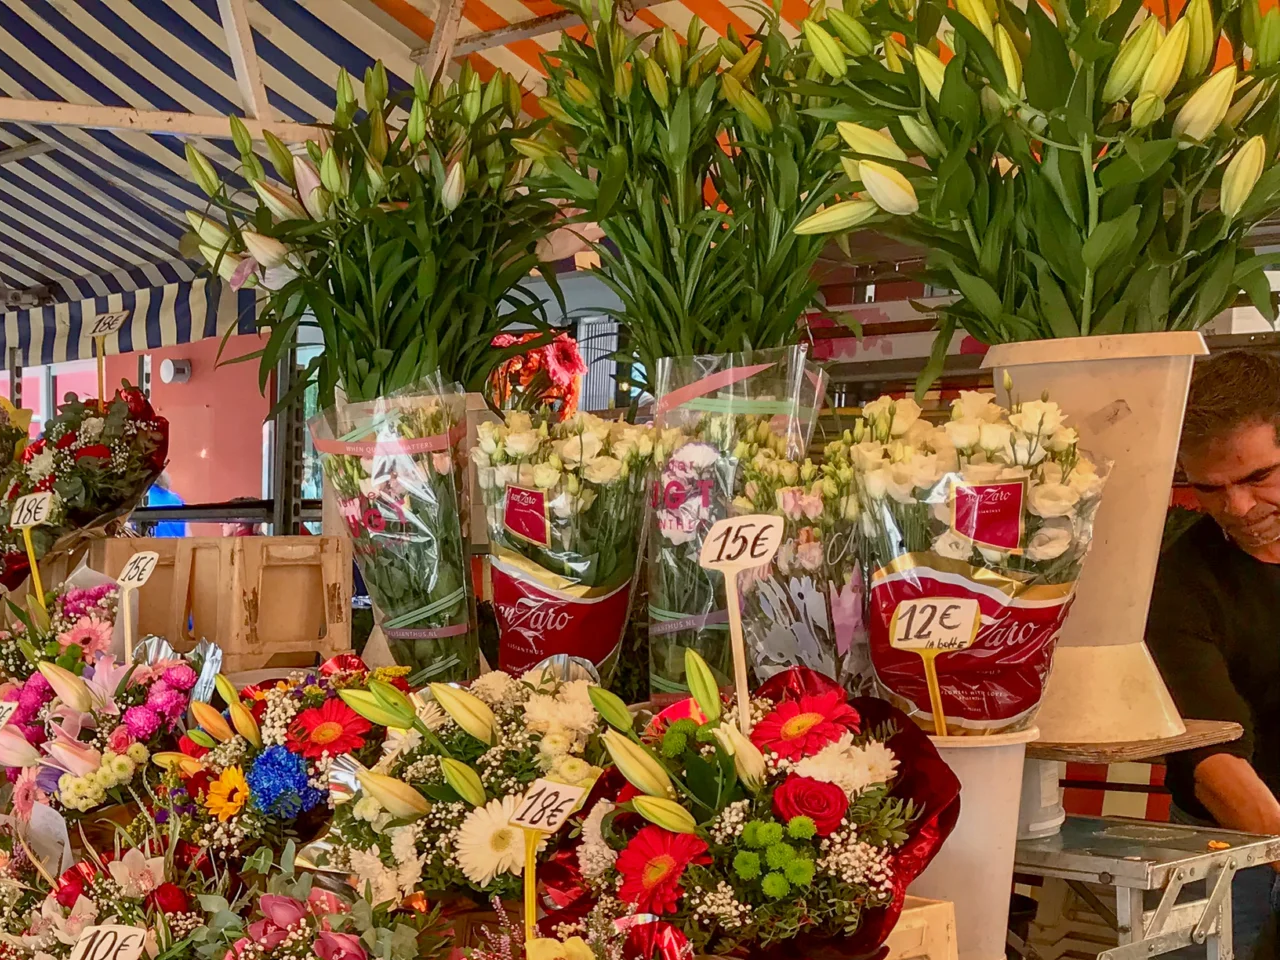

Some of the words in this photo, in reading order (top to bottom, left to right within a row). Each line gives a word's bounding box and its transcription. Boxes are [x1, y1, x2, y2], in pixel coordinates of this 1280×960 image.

[89, 315, 124, 334] 18€
[13, 497, 46, 525] 18€
[708, 523, 774, 563] 15€
[121, 556, 154, 581] 15€
[897, 604, 961, 642] 12€
[515, 787, 575, 827] 18€
